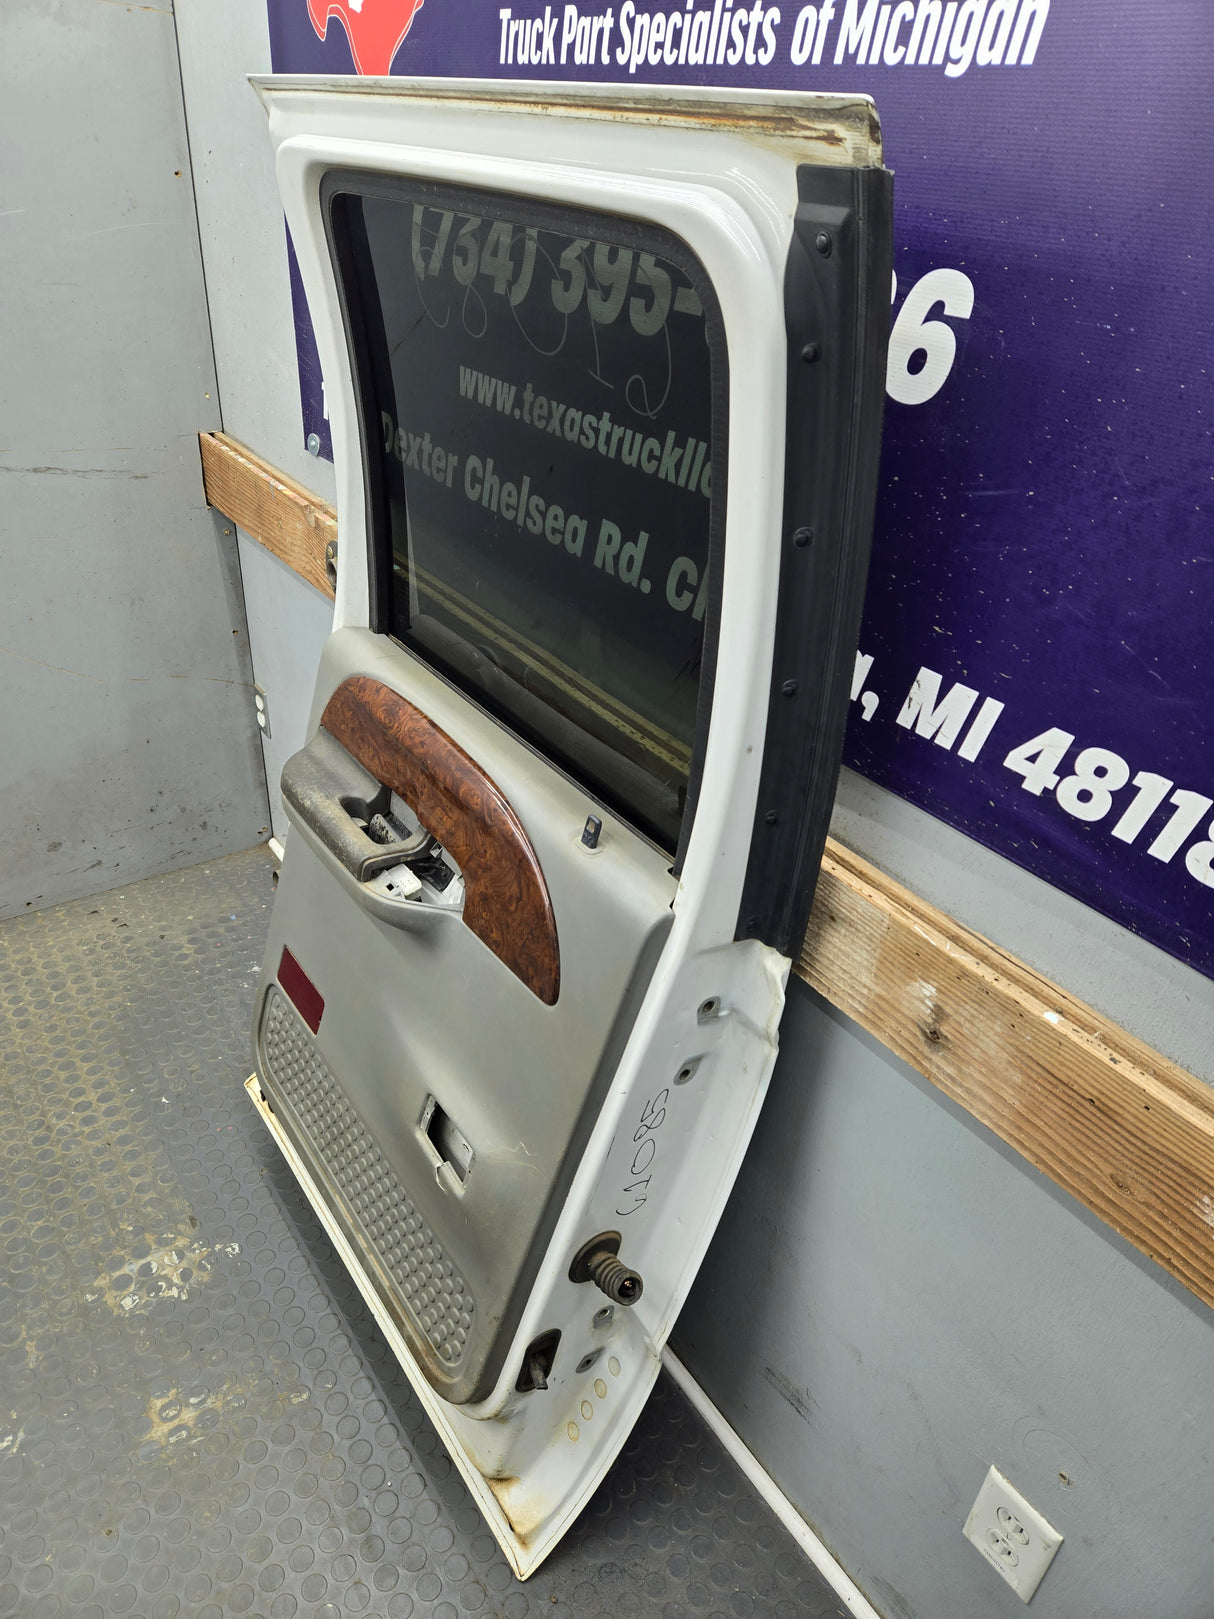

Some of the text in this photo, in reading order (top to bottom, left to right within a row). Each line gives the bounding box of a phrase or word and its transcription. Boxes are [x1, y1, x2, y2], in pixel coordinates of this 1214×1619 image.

[499, 0, 1050, 78] Truck Part Specialists of Michigan
[411, 204, 538, 306] (734)
[885, 268, 974, 405] 6
[464, 454, 588, 558] Chelsea
[593, 518, 651, 594] Rd.
[895, 666, 1005, 763] MI
